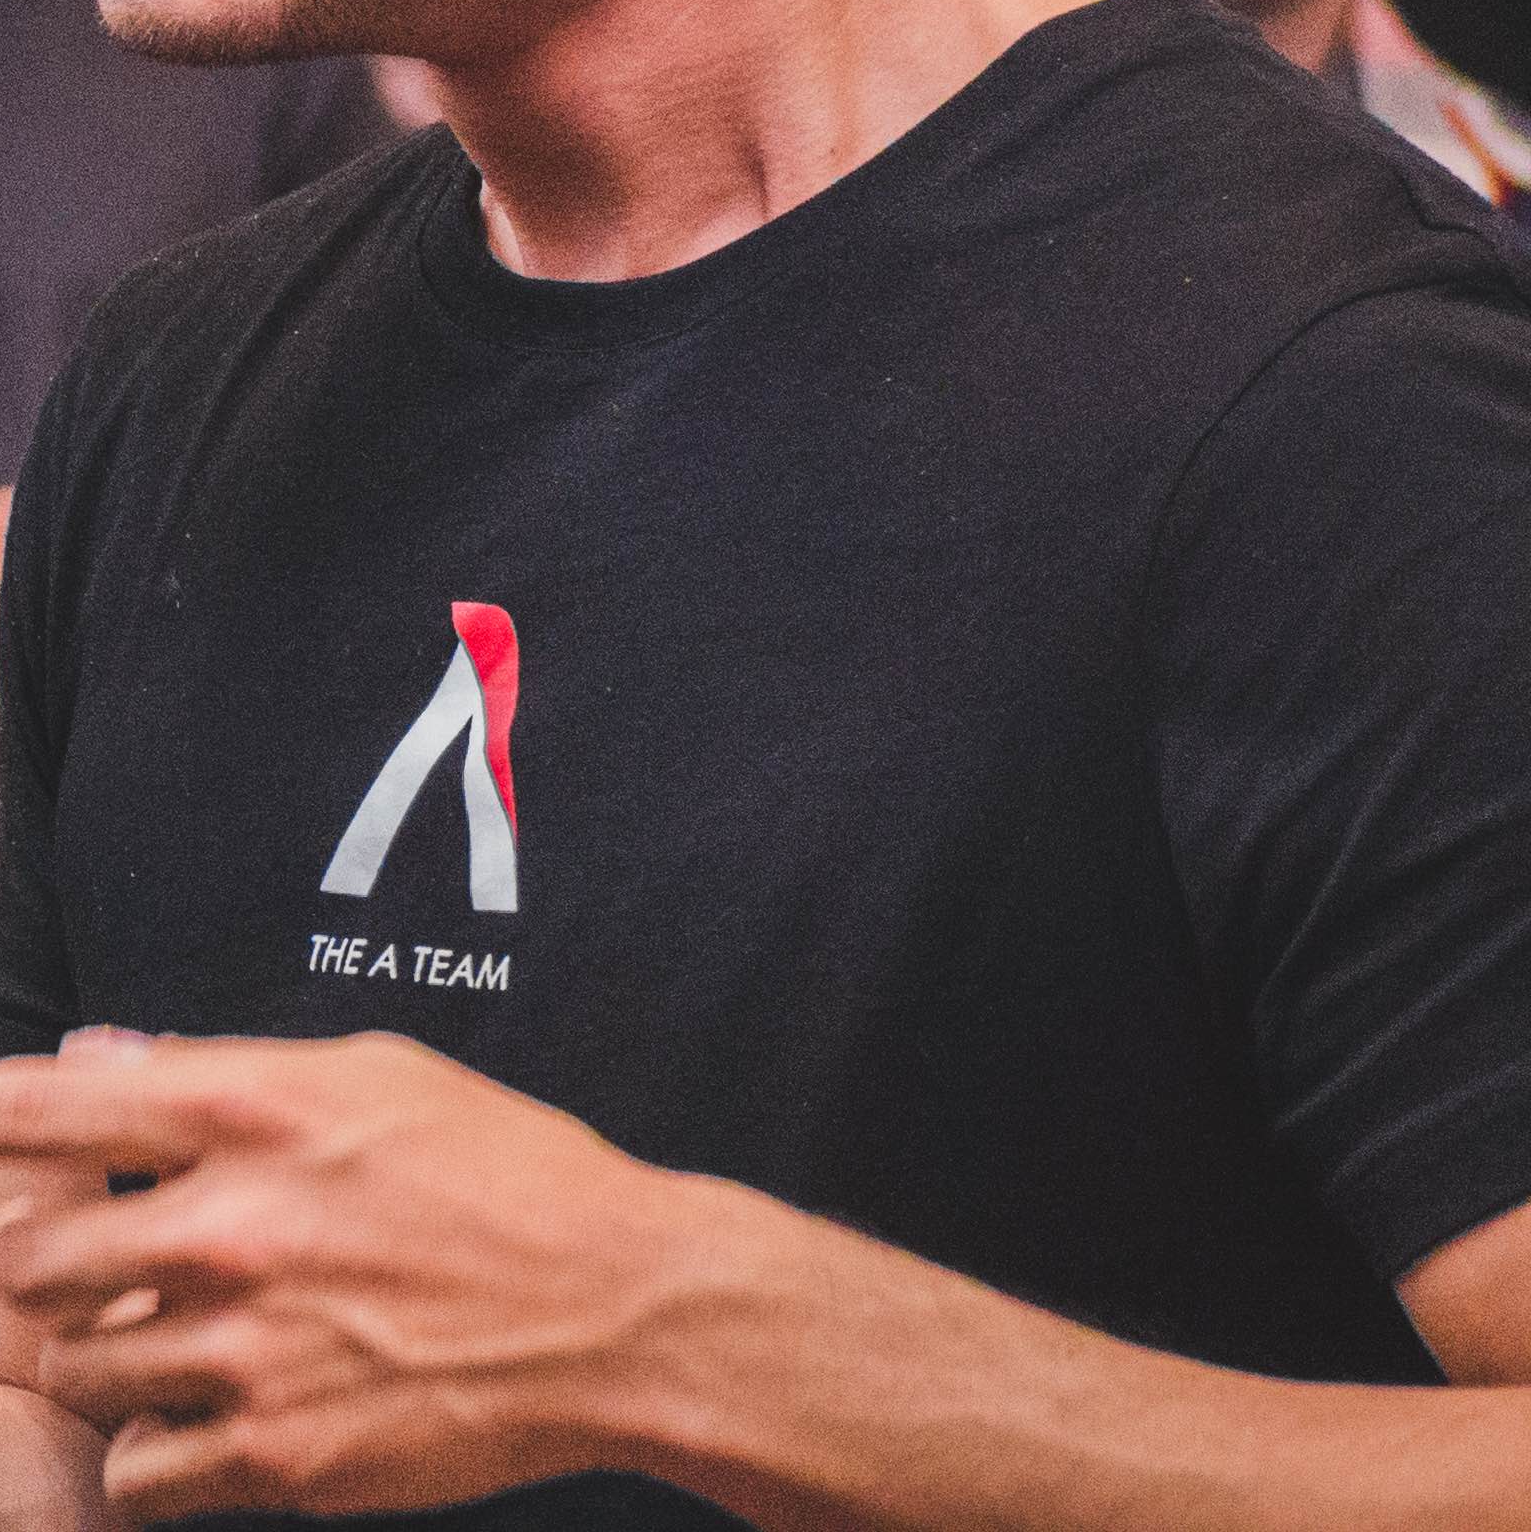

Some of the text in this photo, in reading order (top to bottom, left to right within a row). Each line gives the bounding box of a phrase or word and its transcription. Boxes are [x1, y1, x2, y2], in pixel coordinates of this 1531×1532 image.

[308, 933, 511, 992] THE A TEAM
